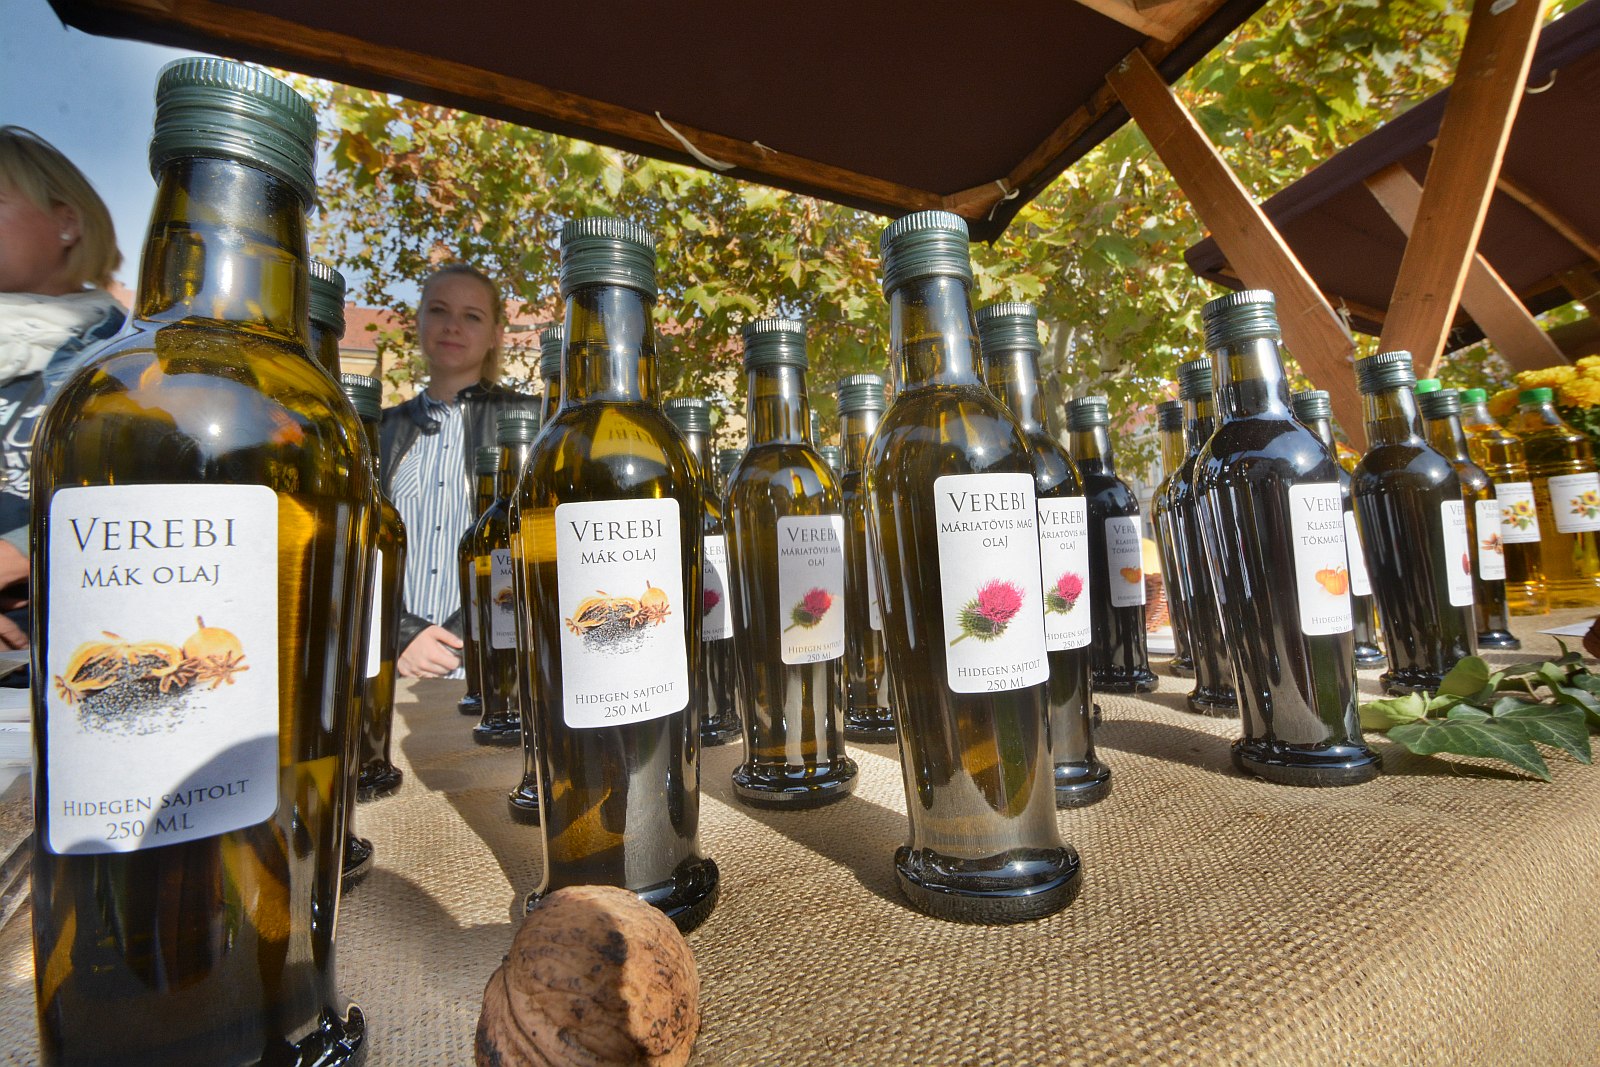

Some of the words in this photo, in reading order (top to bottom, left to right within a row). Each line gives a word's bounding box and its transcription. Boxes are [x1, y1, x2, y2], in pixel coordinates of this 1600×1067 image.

[947, 491, 1026, 513] VEREBI
[1038, 510, 1084, 525] VEREBI
[569, 519, 663, 542] VEREBI
[941, 519, 1014, 533] MÁRIATÖVIS
[1016, 518, 1033, 529] MAG
[68, 517, 237, 552] VEREBI
[1300, 535, 1339, 545] TÖKMAG
[982, 536, 1008, 549] OLAJ
[1059, 541, 1076, 550] OLAJ
[580, 550, 618, 564] MÁK
[622, 548, 656, 562] OLAJ
[808, 557, 825, 567] OLAJ
[81, 565, 143, 588] MÁK
[152, 564, 221, 586] OLAJ
[788, 645, 822, 654] HIDEGEN
[1062, 640, 1075, 649] 250
[807, 654, 820, 662] 250
[958, 665, 1009, 677] HIDEGEN
[1011, 659, 1041, 674] SAJTOLT
[986, 679, 1007, 691] 250
[1010, 677, 1026, 688] ML
[575, 691, 629, 704] HIDEGEN
[633, 682, 675, 699] SAJTOLT
[604, 705, 626, 718] 250
[631, 701, 650, 714] ML
[63, 797, 151, 816] HIDEGEN
[160, 779, 249, 809] SAJTOLT
[106, 820, 145, 840] 250
[154, 812, 194, 835] ML
